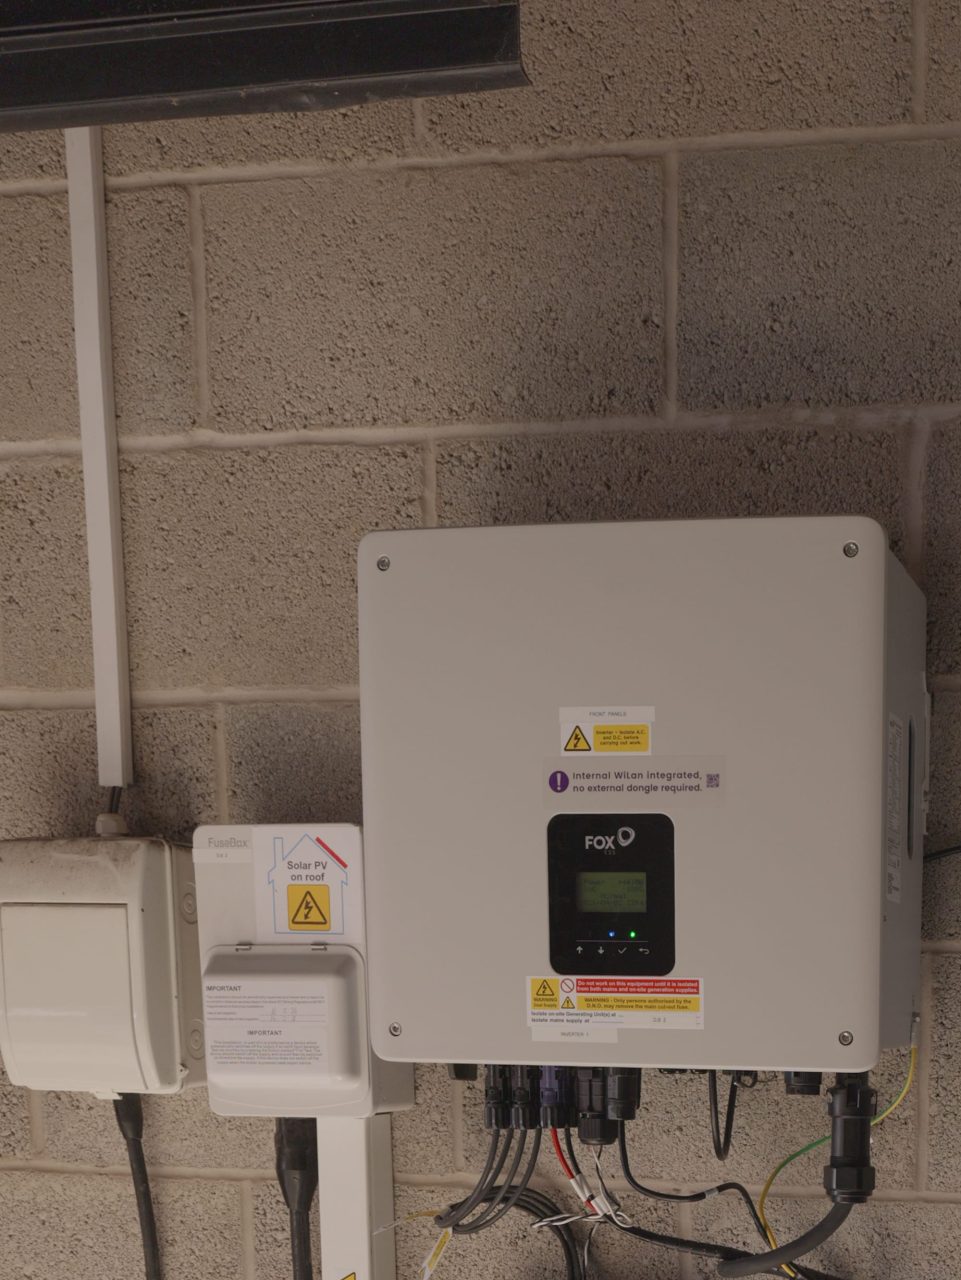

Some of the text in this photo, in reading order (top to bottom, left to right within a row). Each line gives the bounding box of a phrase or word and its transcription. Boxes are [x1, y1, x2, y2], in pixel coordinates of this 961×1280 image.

[573, 771, 702, 781] Internal WiLan integrated,
[588, 784, 624, 792] external
[627, 784, 658, 794] dongle
[661, 783, 702, 794] required.
[585, 836, 615, 849] FOX
[287, 861, 327, 870] Solar PV
[306, 873, 325, 881] roof
